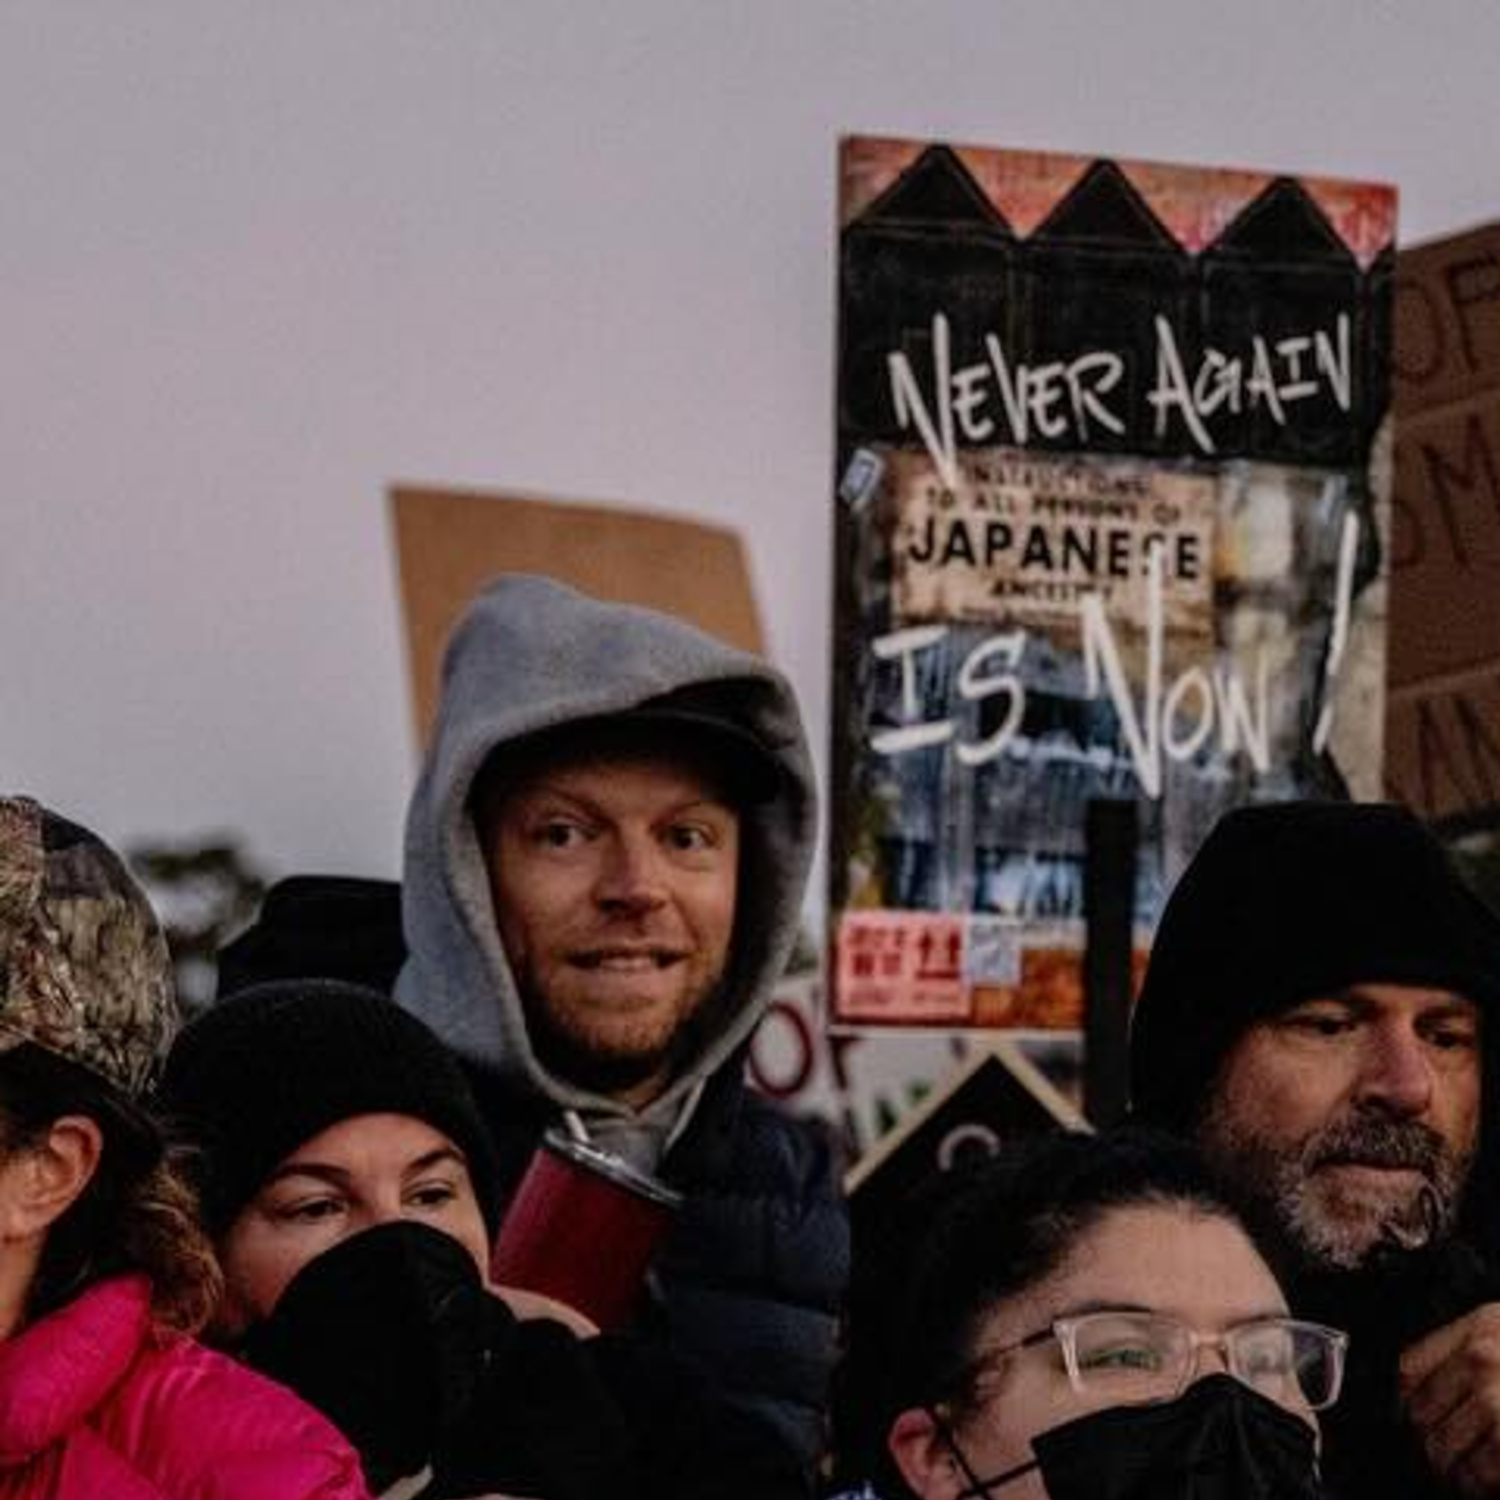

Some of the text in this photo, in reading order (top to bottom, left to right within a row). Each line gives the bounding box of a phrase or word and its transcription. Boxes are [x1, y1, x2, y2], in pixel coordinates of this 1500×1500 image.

[888, 312, 1350, 490] NEVER AGAIN
[870, 623, 1026, 766] IS
